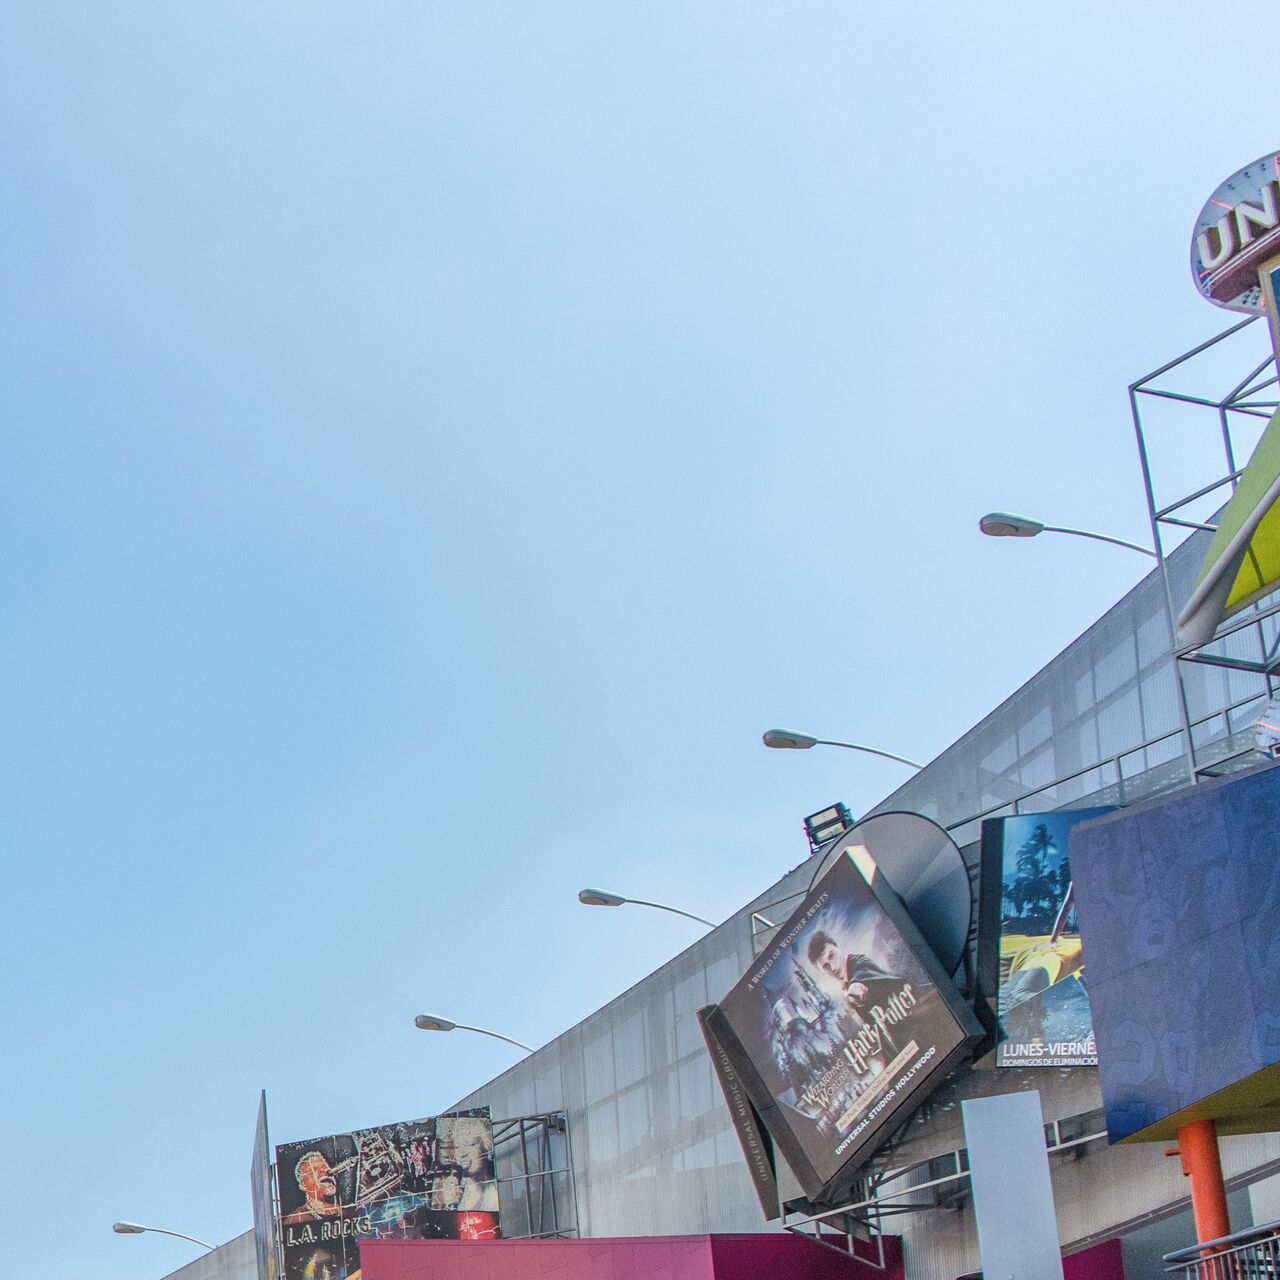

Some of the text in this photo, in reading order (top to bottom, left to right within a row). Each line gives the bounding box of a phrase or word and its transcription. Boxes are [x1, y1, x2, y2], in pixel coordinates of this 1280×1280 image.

[844, 983, 917, 1075] Harry Potter
[1003, 1042, 1098, 1056] LUNES-VIERNE
[835, 1046, 936, 1154] UNIVERSAL STUDIOS HOLLYWOOD
[286, 1216, 370, 1247] L.A. ROCKS
